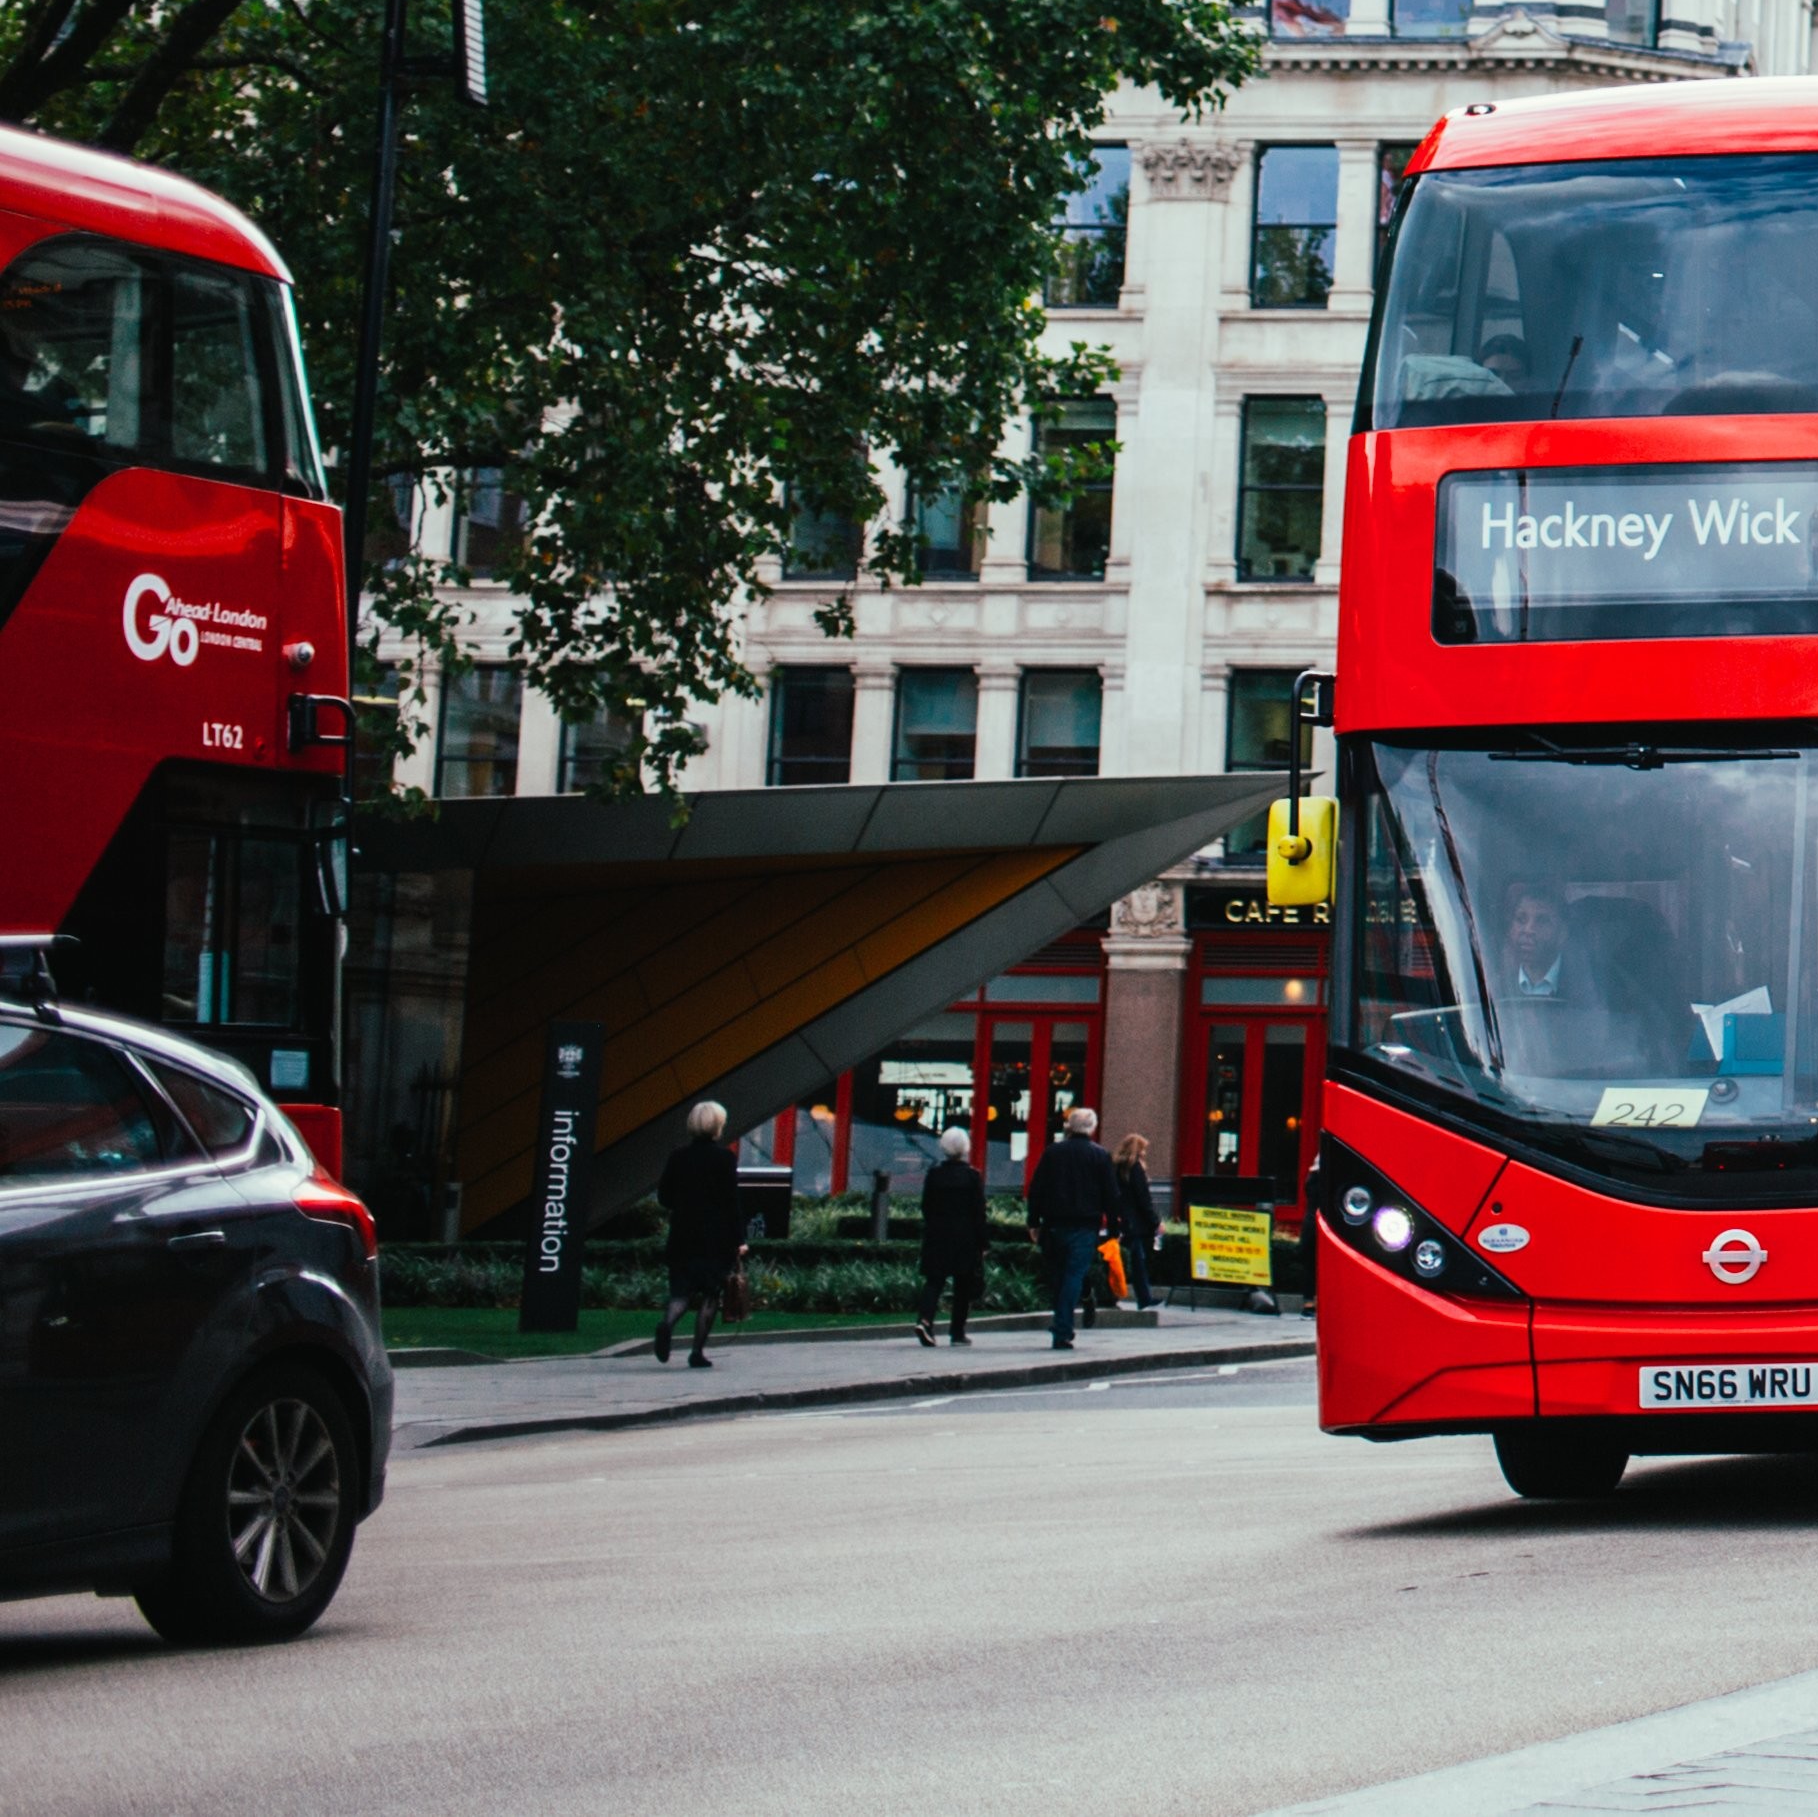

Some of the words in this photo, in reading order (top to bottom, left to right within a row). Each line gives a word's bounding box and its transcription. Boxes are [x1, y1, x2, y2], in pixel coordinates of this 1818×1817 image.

[1480, 501, 1673, 561] Hackney
[1688, 497, 1801, 546] Wick
[123, 573, 199, 666] Go
[200, 631, 231, 647] LONDON
[202, 722, 244, 750] LT62
[1606, 1102, 1685, 1127] 242
[539, 1110, 580, 1273] information
[1653, 1369, 1738, 1401] SN66
[1748, 1367, 1811, 1398] WRU
